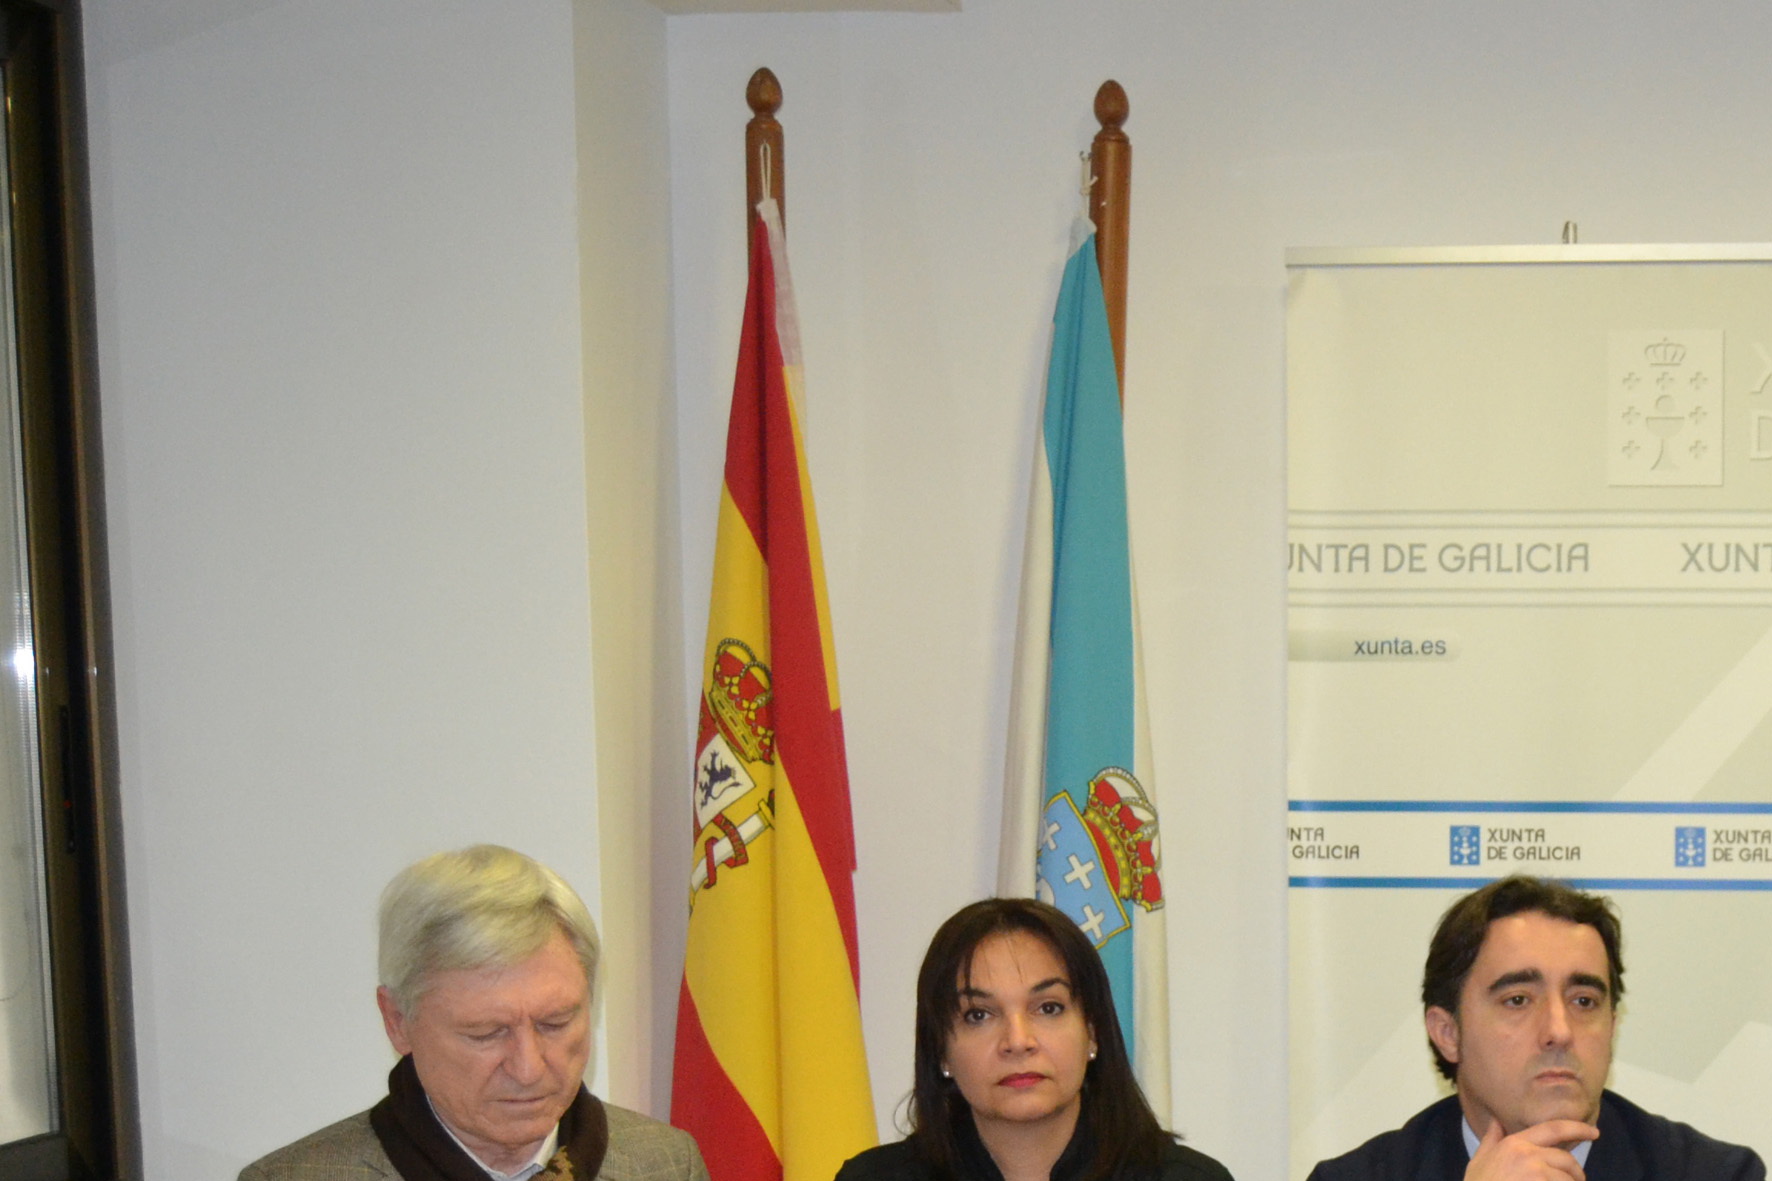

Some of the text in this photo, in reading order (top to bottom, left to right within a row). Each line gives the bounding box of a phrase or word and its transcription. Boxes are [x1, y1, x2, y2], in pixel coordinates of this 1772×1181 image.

[1382, 543, 1428, 573] DE
[1437, 543, 1590, 573] GALICIA
[1354, 637, 1446, 657] xunta.es
[1487, 828, 1545, 843] XUNTA
[1713, 829, 1771, 844] XUNTA
[1291, 845, 1360, 860] GALICIA
[1487, 846, 1581, 861] DE GALICIA
[1713, 848, 1733, 862] DE
